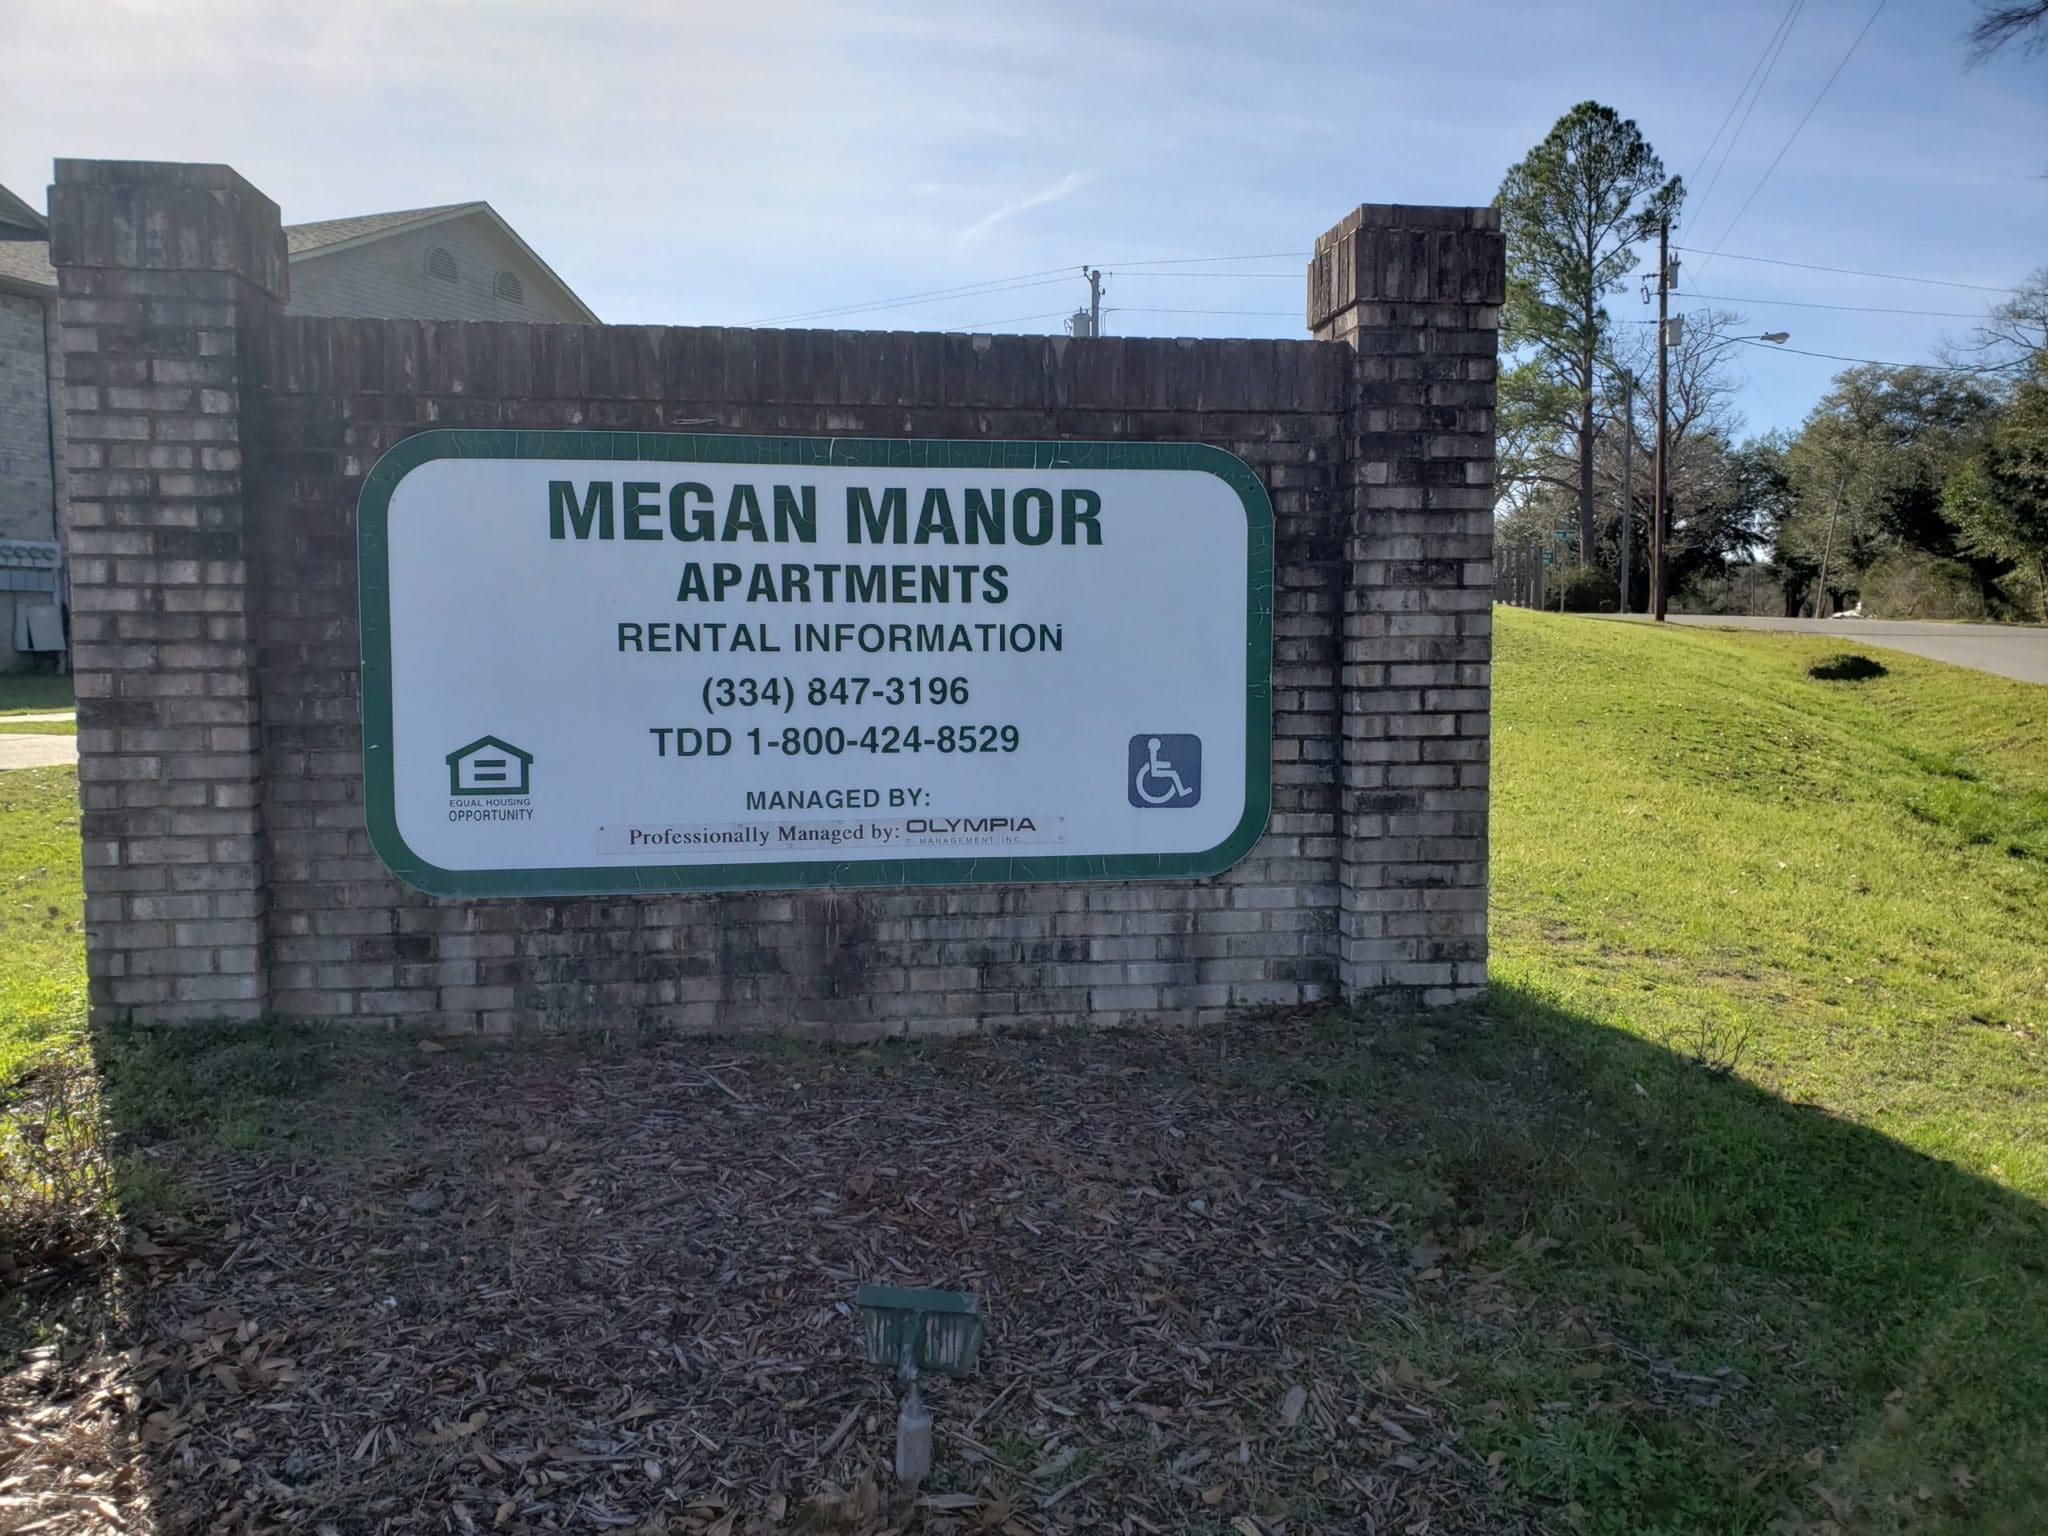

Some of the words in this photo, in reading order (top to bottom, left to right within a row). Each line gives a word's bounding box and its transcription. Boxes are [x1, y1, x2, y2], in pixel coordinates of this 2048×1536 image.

[549, 481, 816, 543] MEGAN
[846, 487, 1103, 546] MANOR
[677, 563, 1009, 604] APARTMENTS
[618, 623, 780, 652] RENTAL
[795, 624, 1063, 653] INFORMATION
[702, 677, 795, 714] (334)
[808, 677, 970, 707] 847-3196
[649, 728, 732, 756] TDD
[746, 725, 1020, 756] 1-800-424-8529
[449, 799, 483, 807] EQUAL
[486, 798, 531, 807] HOUSING
[746, 788, 880, 811] MANAGED
[889, 788, 931, 808] BY:
[448, 808, 534, 822] OPPORTUNITY
[905, 817, 1037, 834] OLYMPIA
[629, 826, 770, 847] Professionally
[777, 825, 865, 845] Managed
[871, 823, 900, 843] by:
